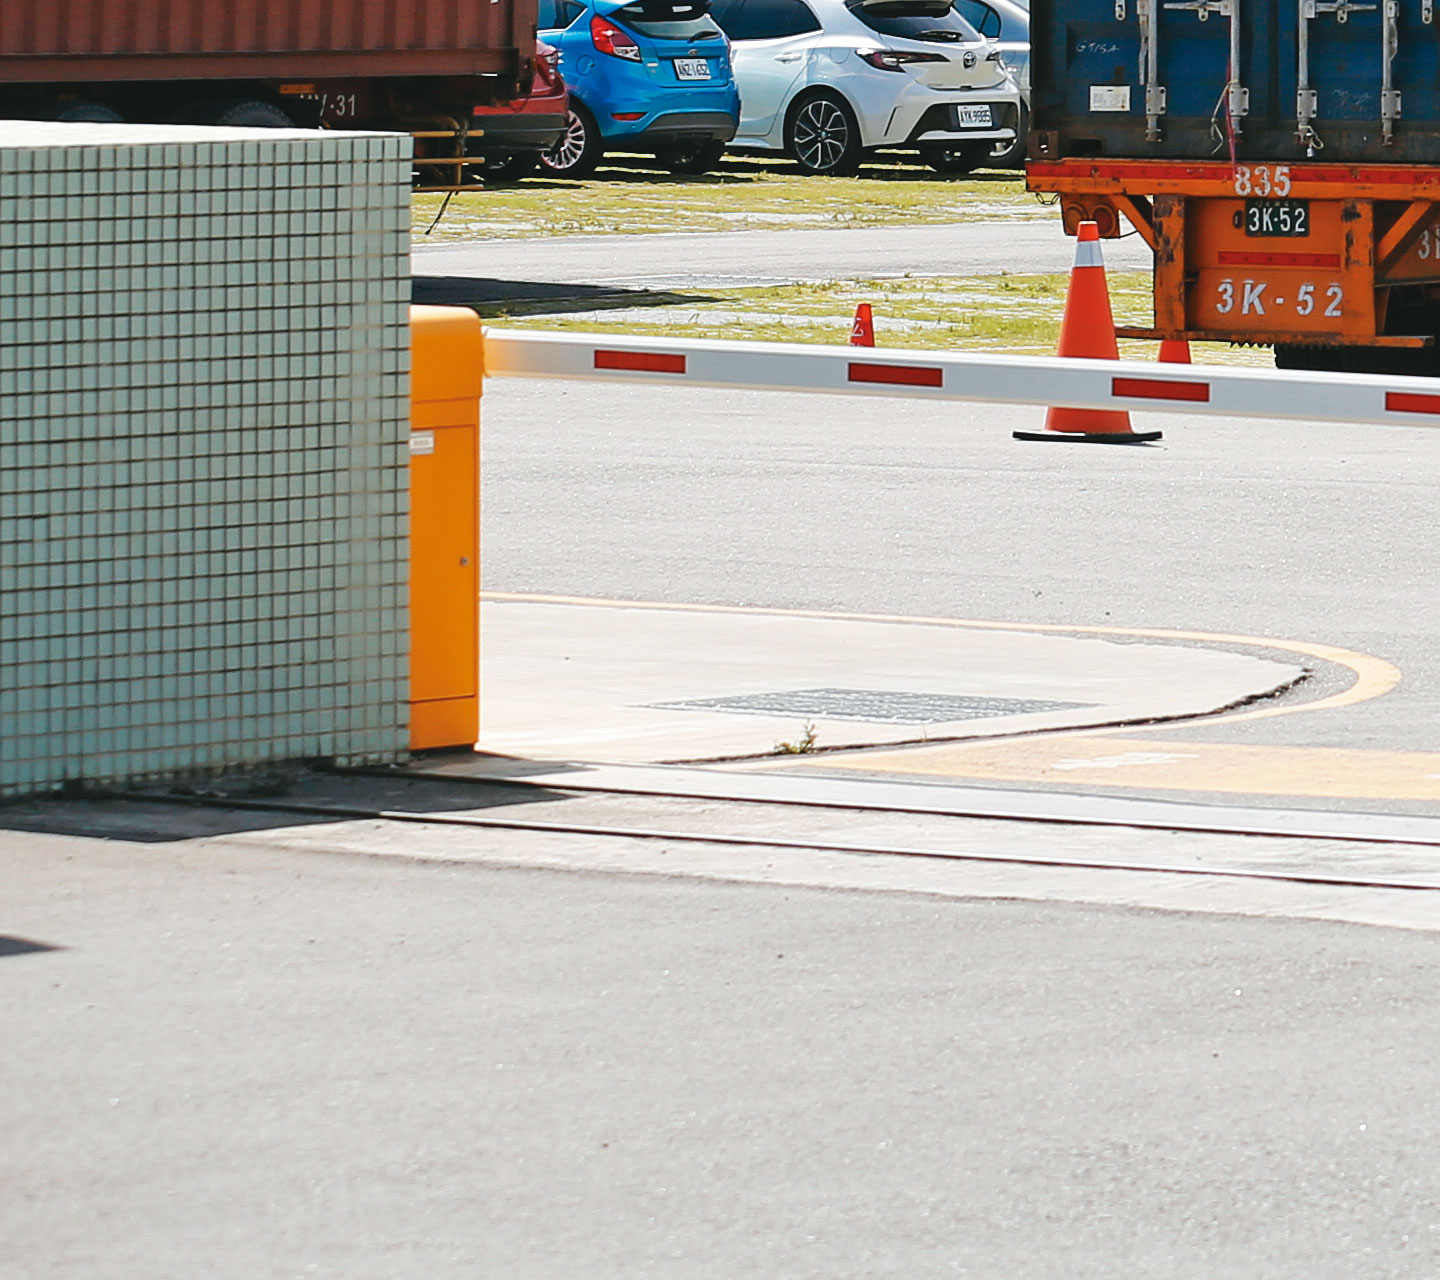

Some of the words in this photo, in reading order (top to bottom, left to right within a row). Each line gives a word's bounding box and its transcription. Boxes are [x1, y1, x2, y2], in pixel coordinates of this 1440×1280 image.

[1234, 166, 1292, 197] 835
[1249, 208, 1306, 232] 3K-52
[1216, 279, 1343, 316] 3K-52
